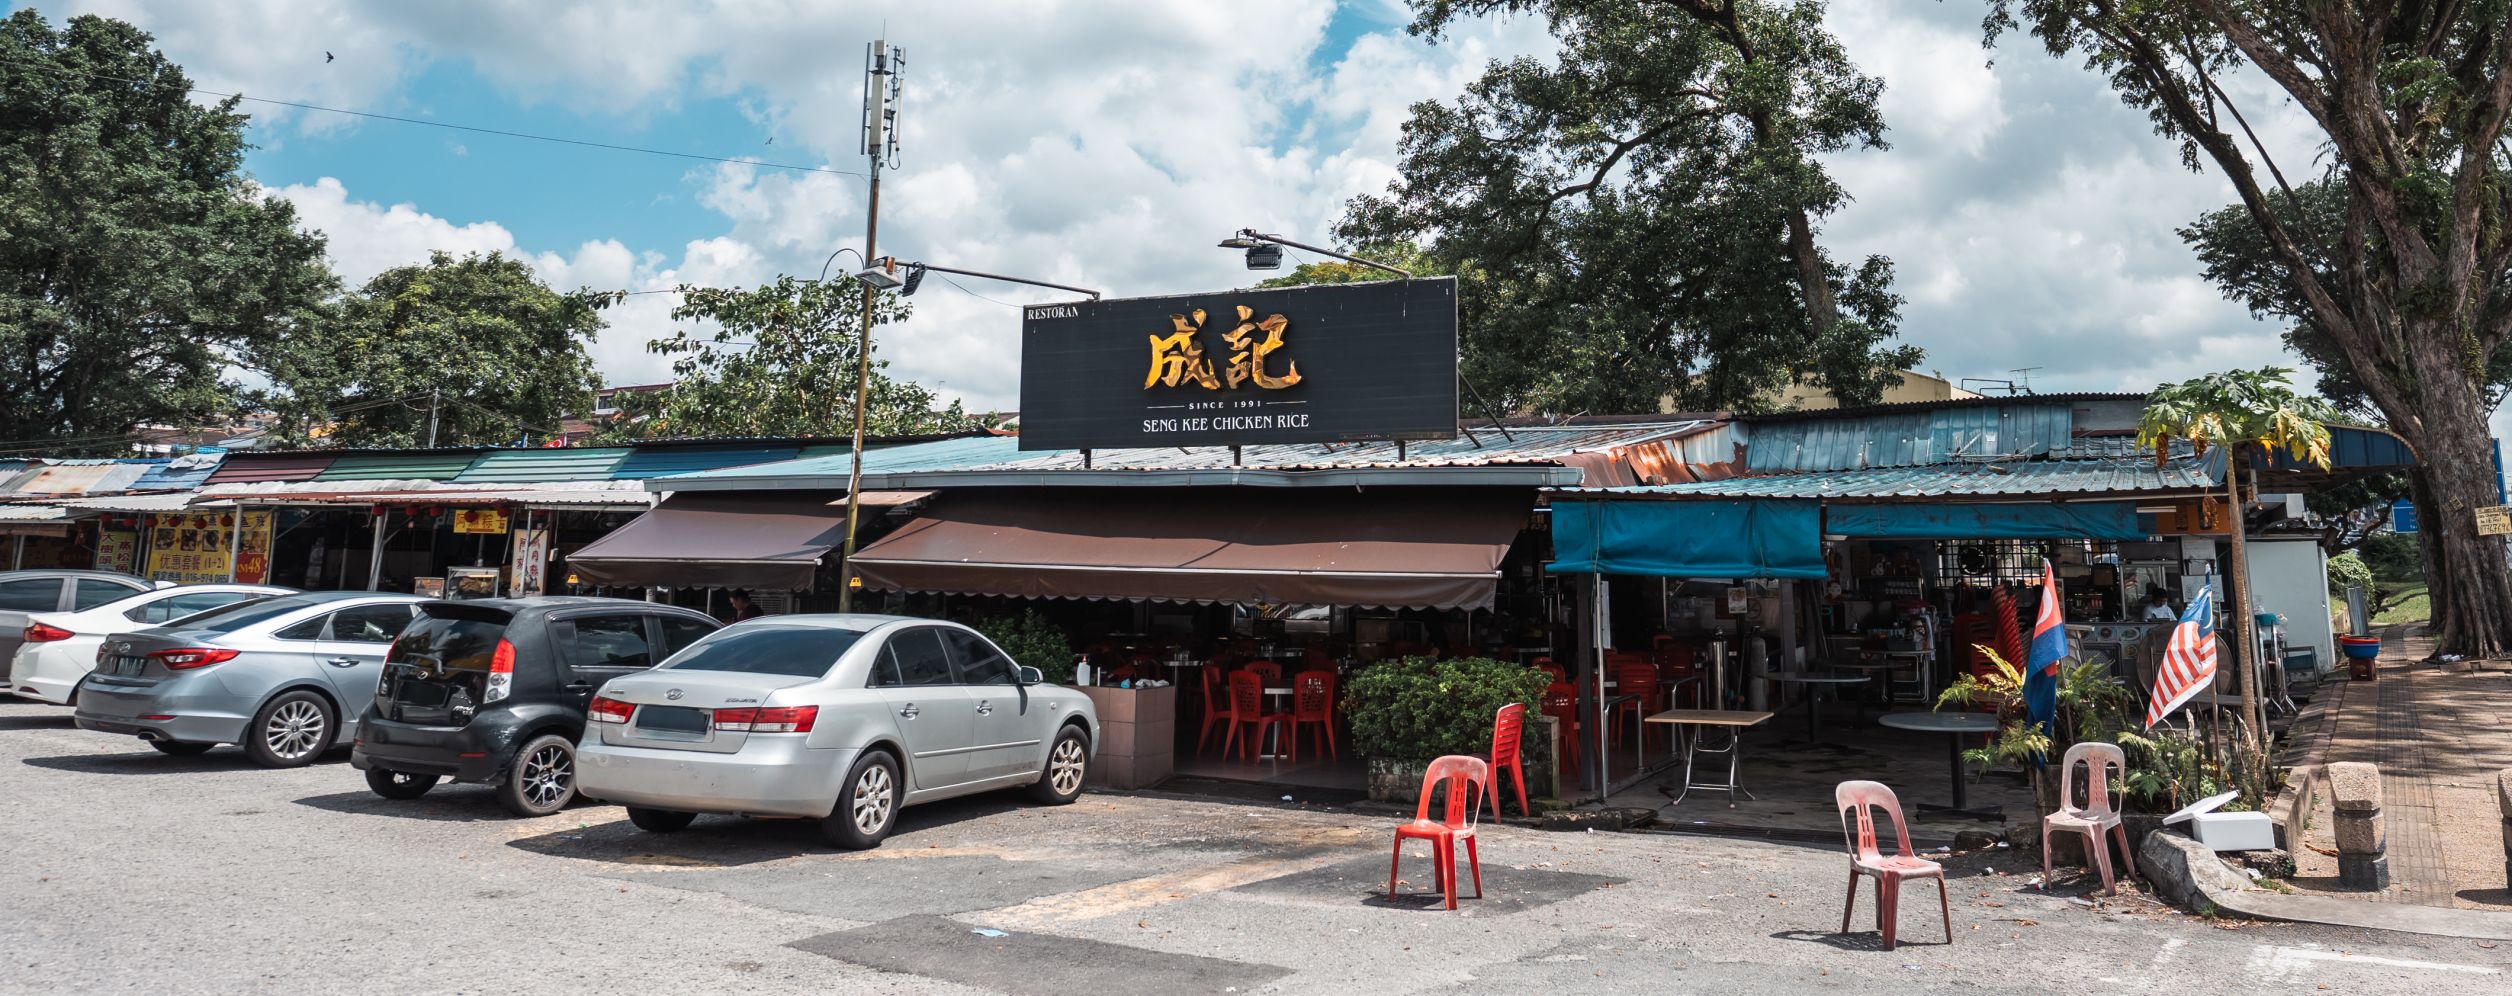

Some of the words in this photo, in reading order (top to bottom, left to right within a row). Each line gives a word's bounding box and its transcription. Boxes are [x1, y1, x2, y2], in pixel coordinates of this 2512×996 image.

[1028, 306, 1079, 320] RESTORAN
[1144, 305, 1302, 391] 成記
[1188, 401, 1225, 410] SINCE
[1234, 400, 1262, 408] 1991
[1143, 418, 1178, 433] SENG
[1182, 417, 1209, 432] KEE
[1212, 415, 1273, 430] CHICKEN
[1277, 414, 1310, 429] RICE
